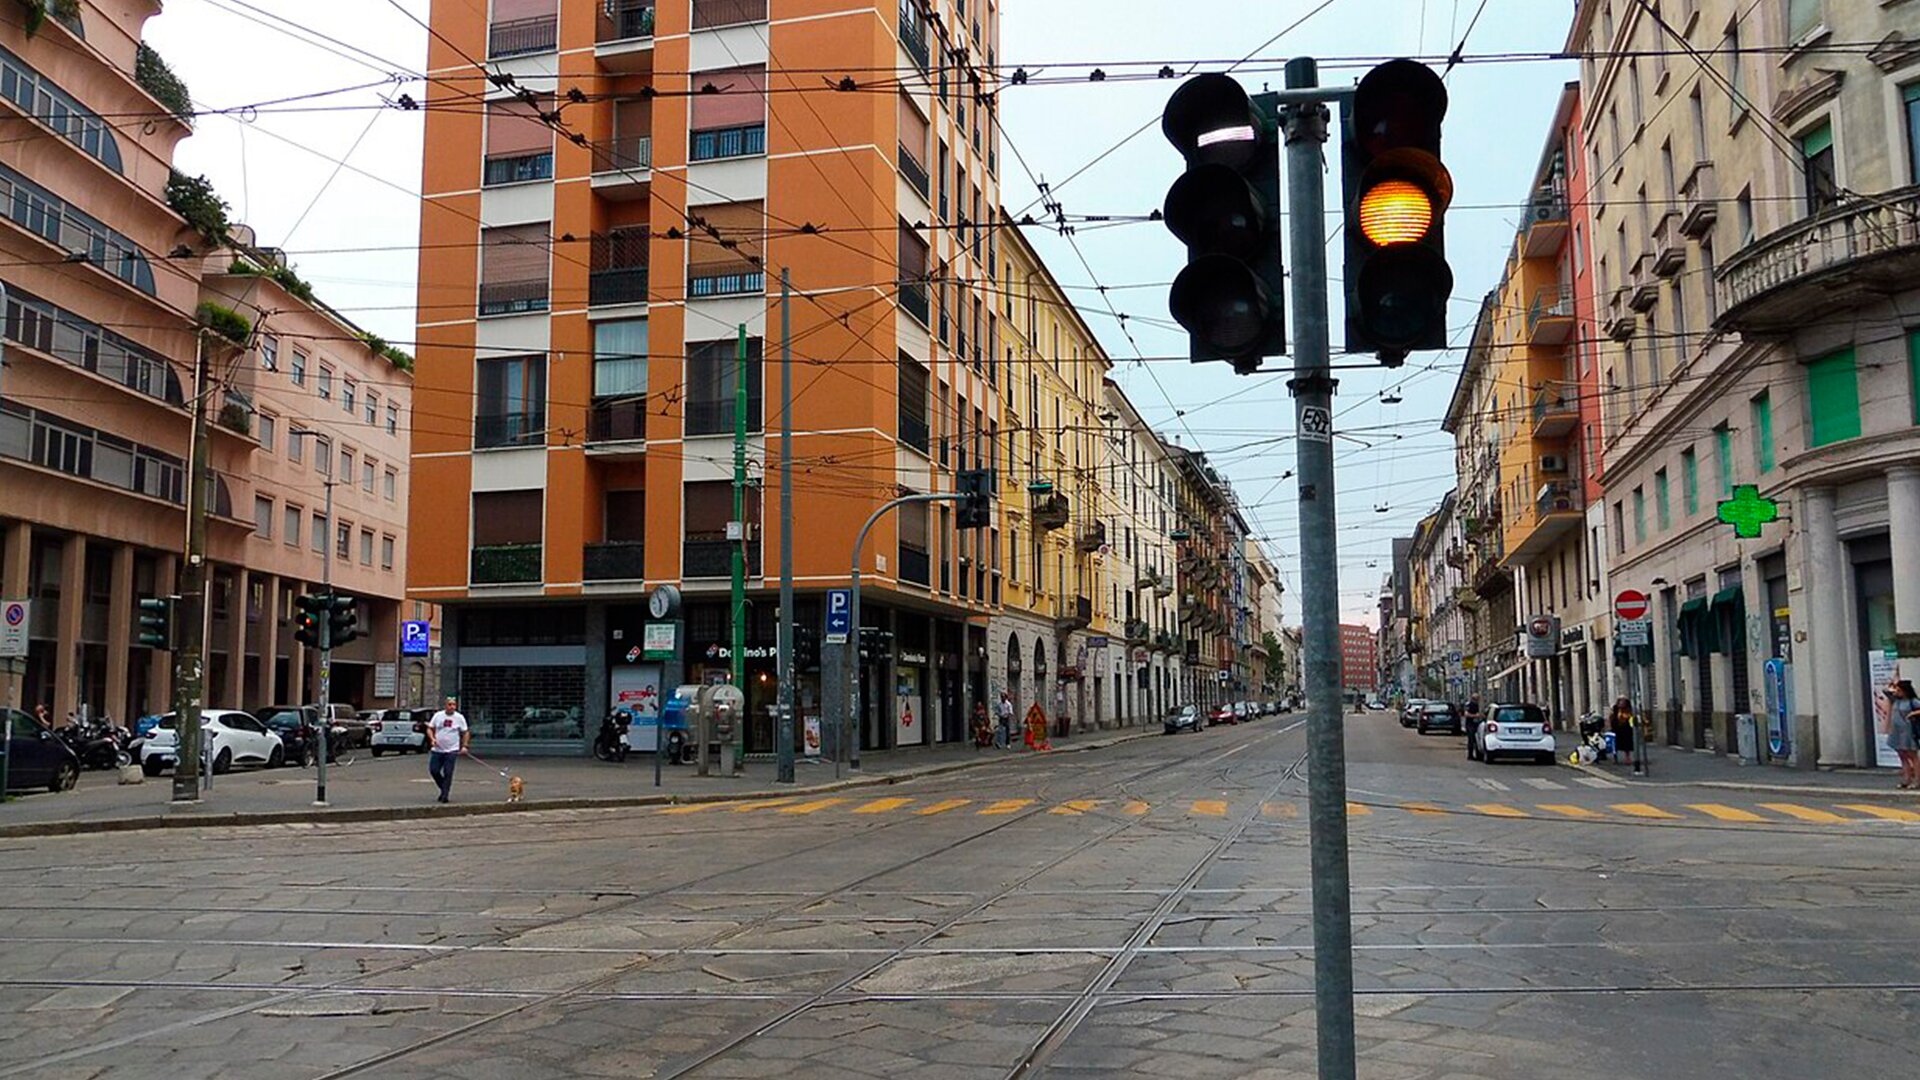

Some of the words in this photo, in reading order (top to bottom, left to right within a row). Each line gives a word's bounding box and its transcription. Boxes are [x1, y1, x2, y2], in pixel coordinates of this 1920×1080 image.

[831, 592, 846, 614] P
[407, 624, 420, 641] P
[719, 647, 767, 657] Doino's
